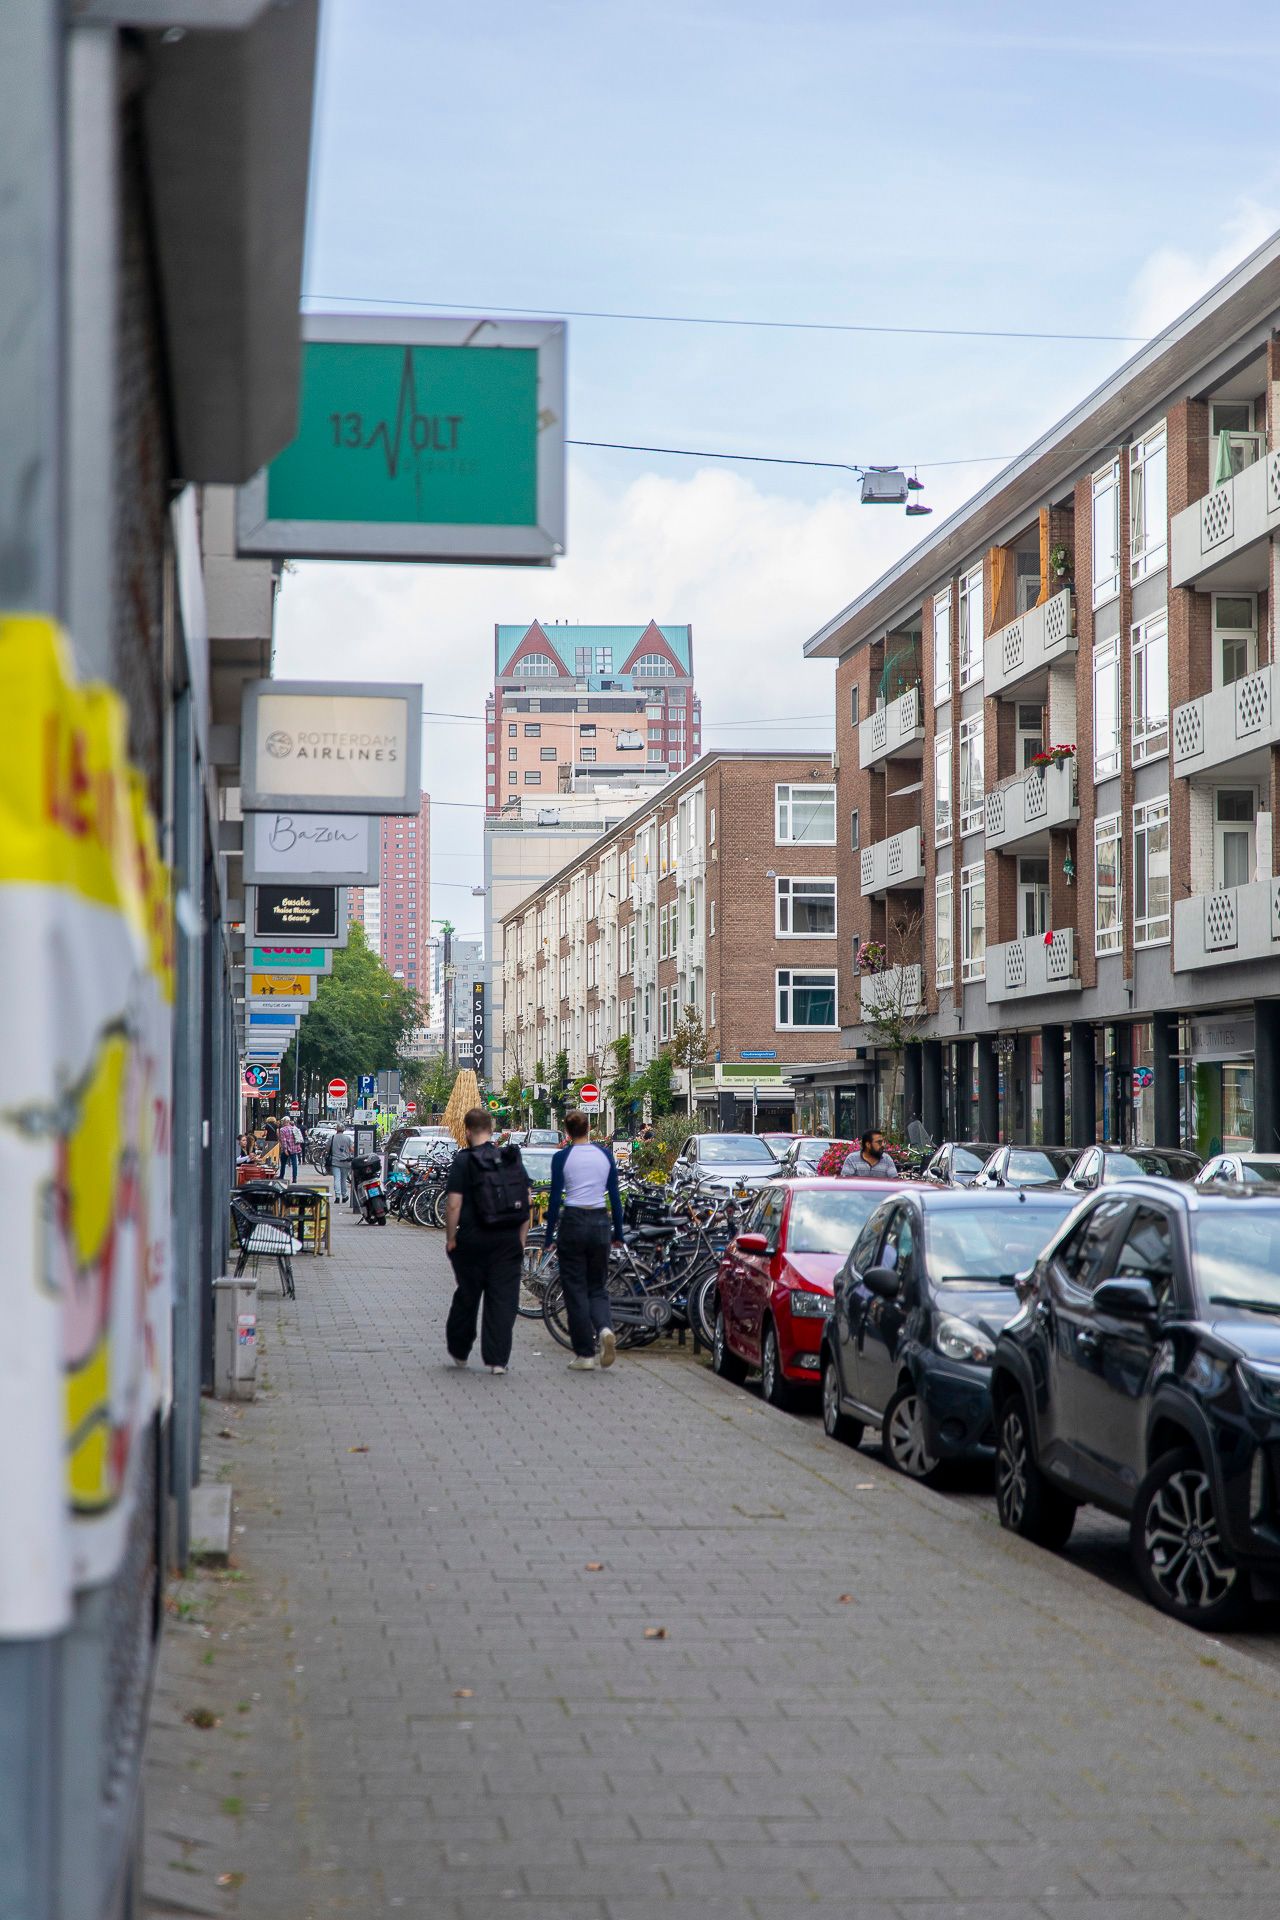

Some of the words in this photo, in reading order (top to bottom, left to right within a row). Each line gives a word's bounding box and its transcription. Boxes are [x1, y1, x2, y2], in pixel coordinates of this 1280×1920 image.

[297, 731, 398, 747] ROTTERDAM
[296, 747, 398, 762] AIRLINES
[292, 907, 320, 915] Massage
[474, 1000, 483, 1068] SAVOY
[362, 1076, 371, 1088] P
